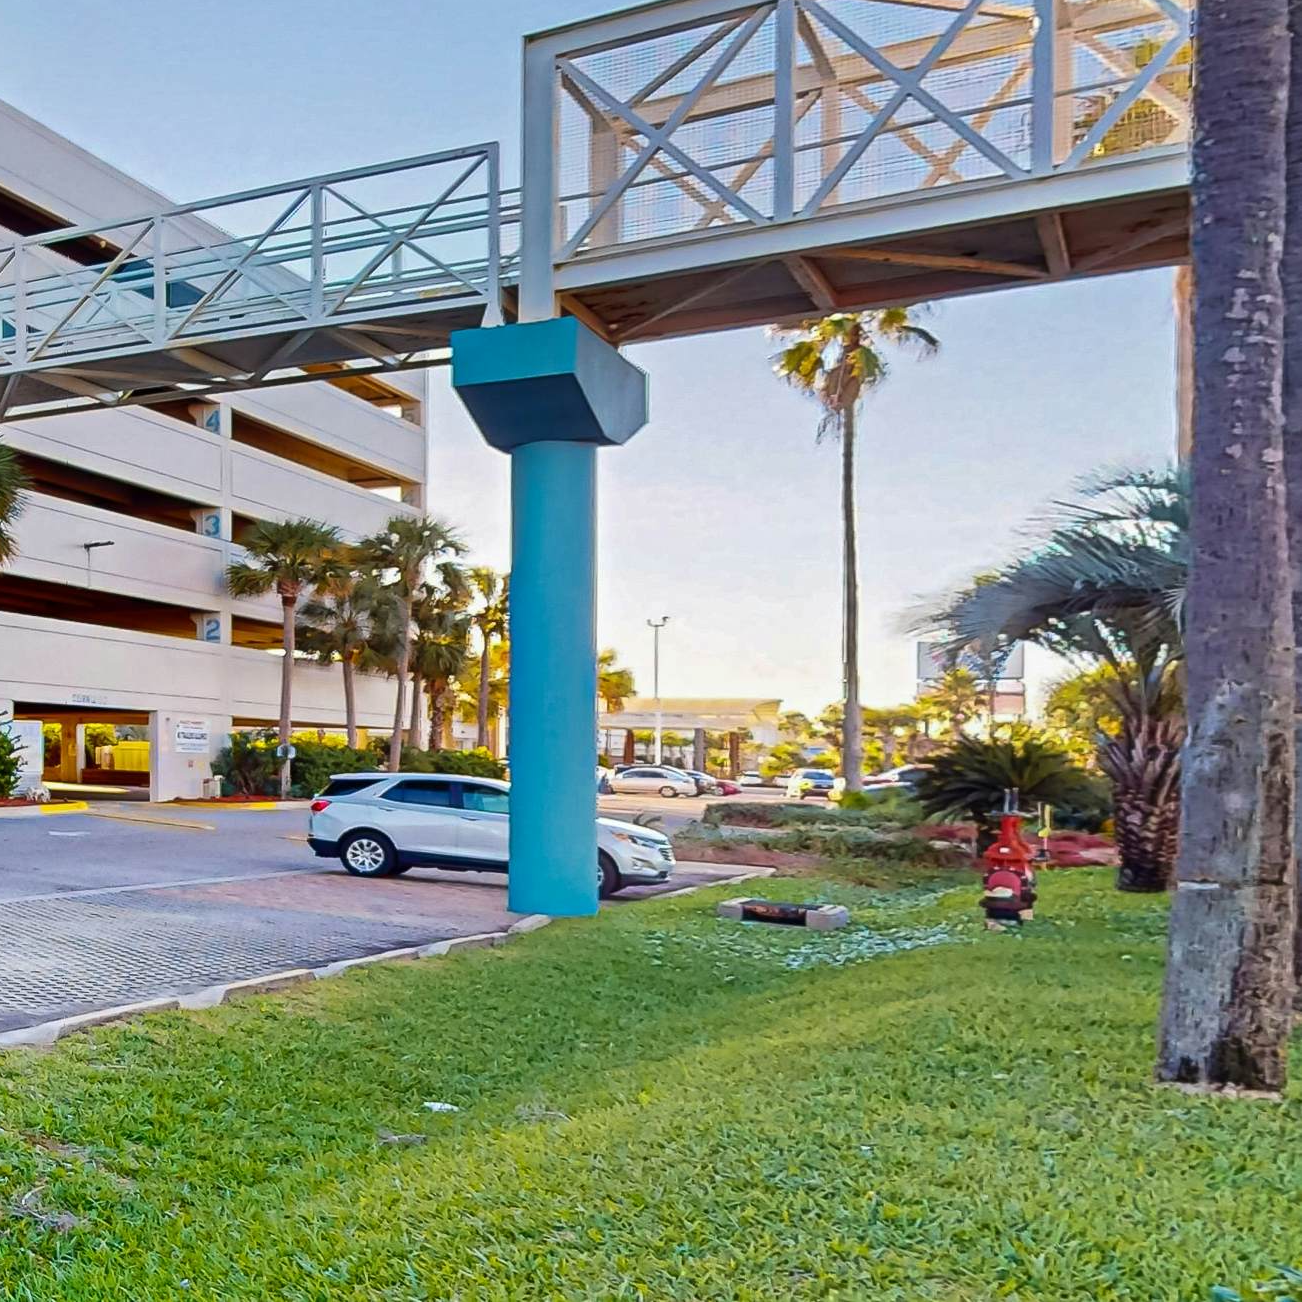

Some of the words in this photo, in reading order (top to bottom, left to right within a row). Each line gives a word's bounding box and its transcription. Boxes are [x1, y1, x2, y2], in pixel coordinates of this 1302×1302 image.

[206, 409, 220, 433] 4
[204, 514, 220, 536] 3
[206, 618, 220, 640] 2
